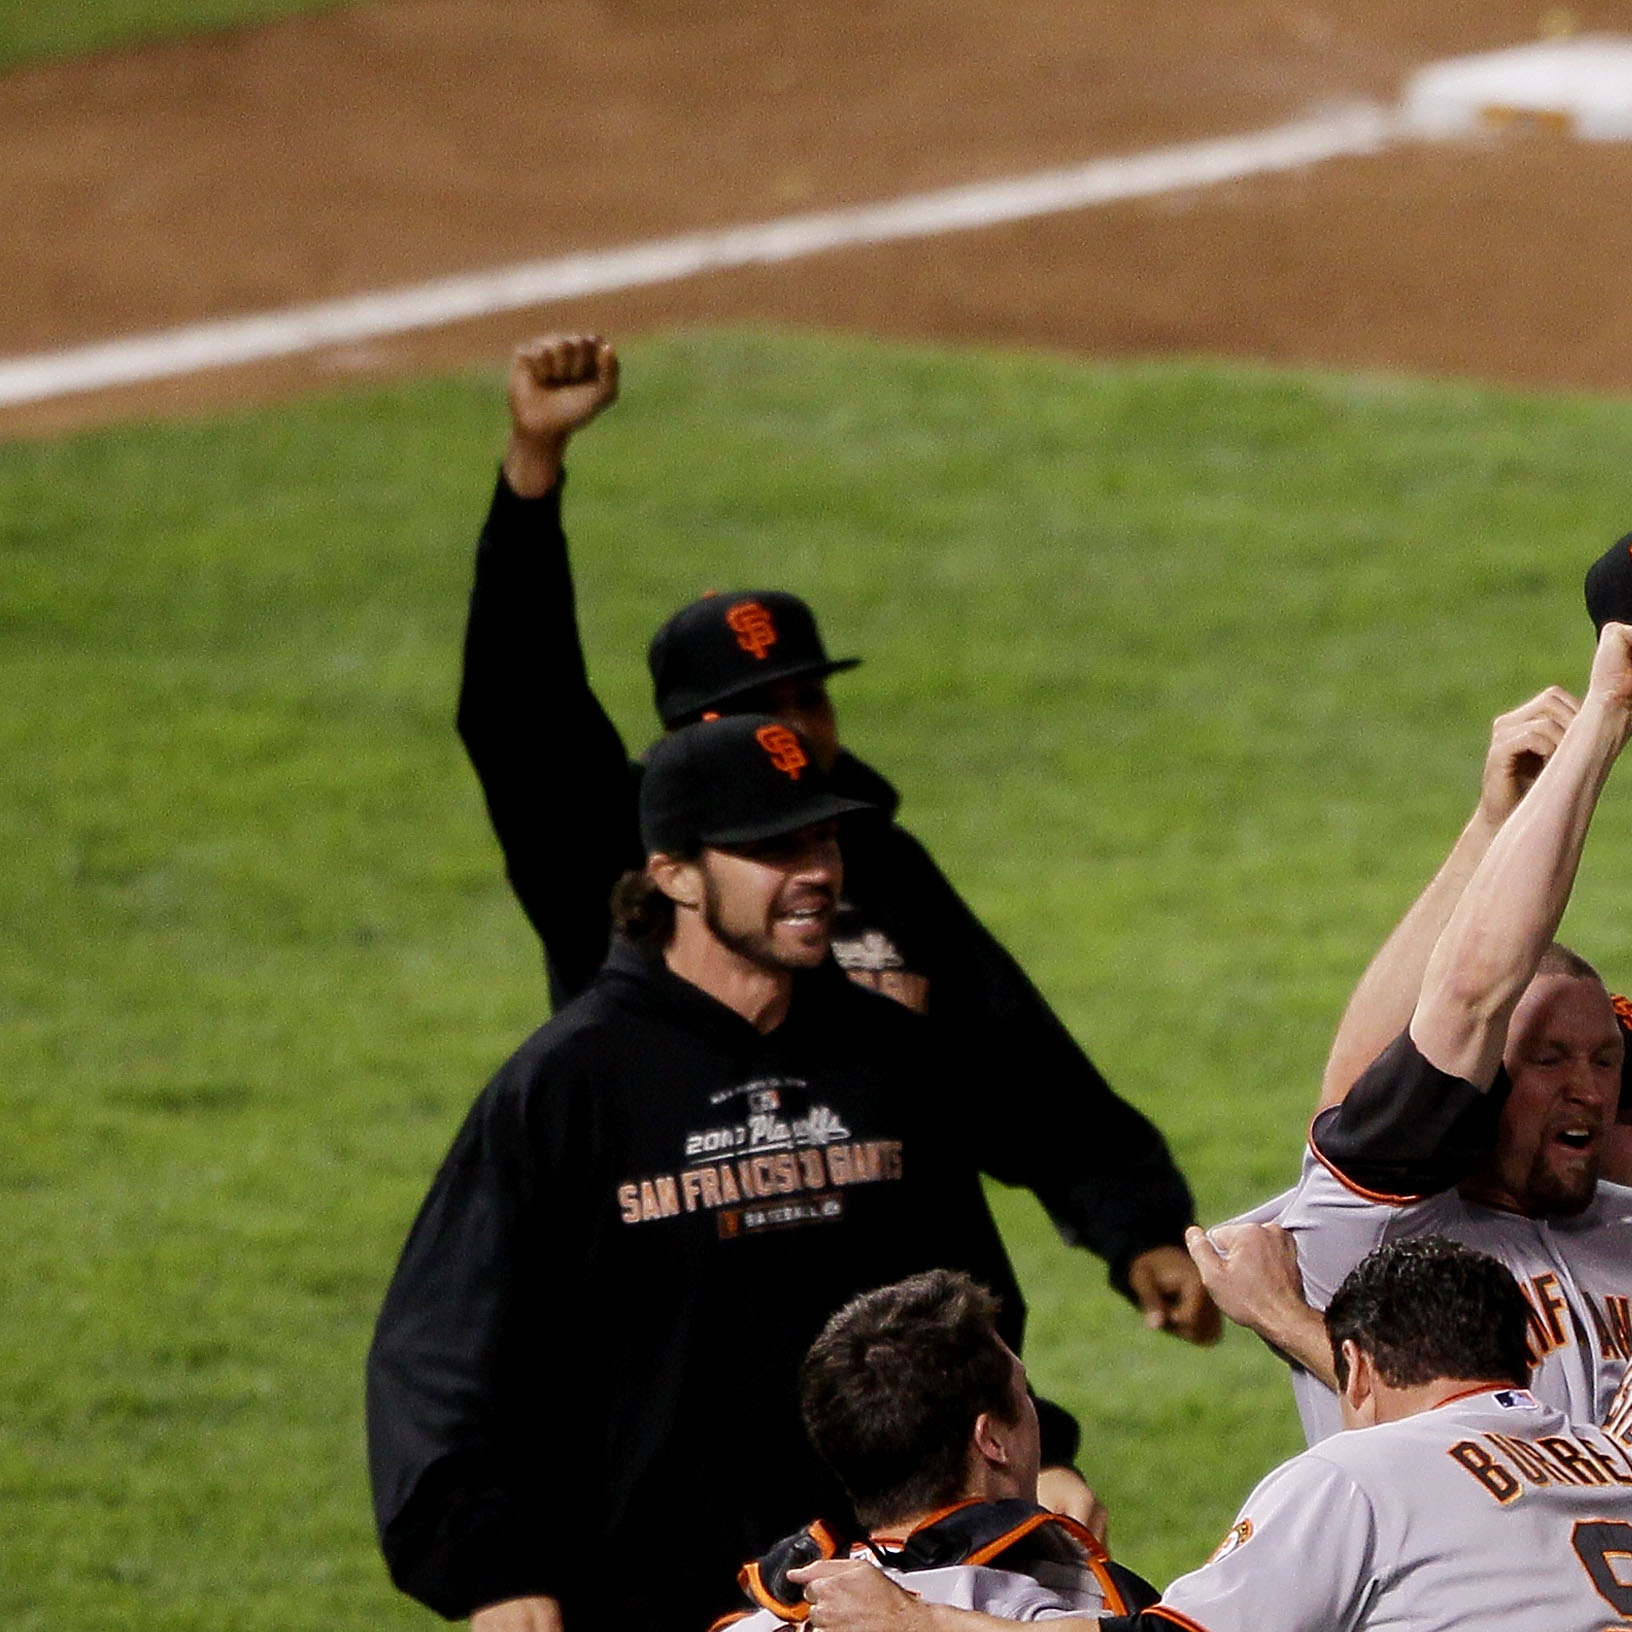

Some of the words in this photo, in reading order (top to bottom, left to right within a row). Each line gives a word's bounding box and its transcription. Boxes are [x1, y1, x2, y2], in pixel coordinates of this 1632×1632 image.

[726, 602, 776, 660] SF
[756, 724, 807, 780] SF
[617, 1175, 680, 1224] SAN
